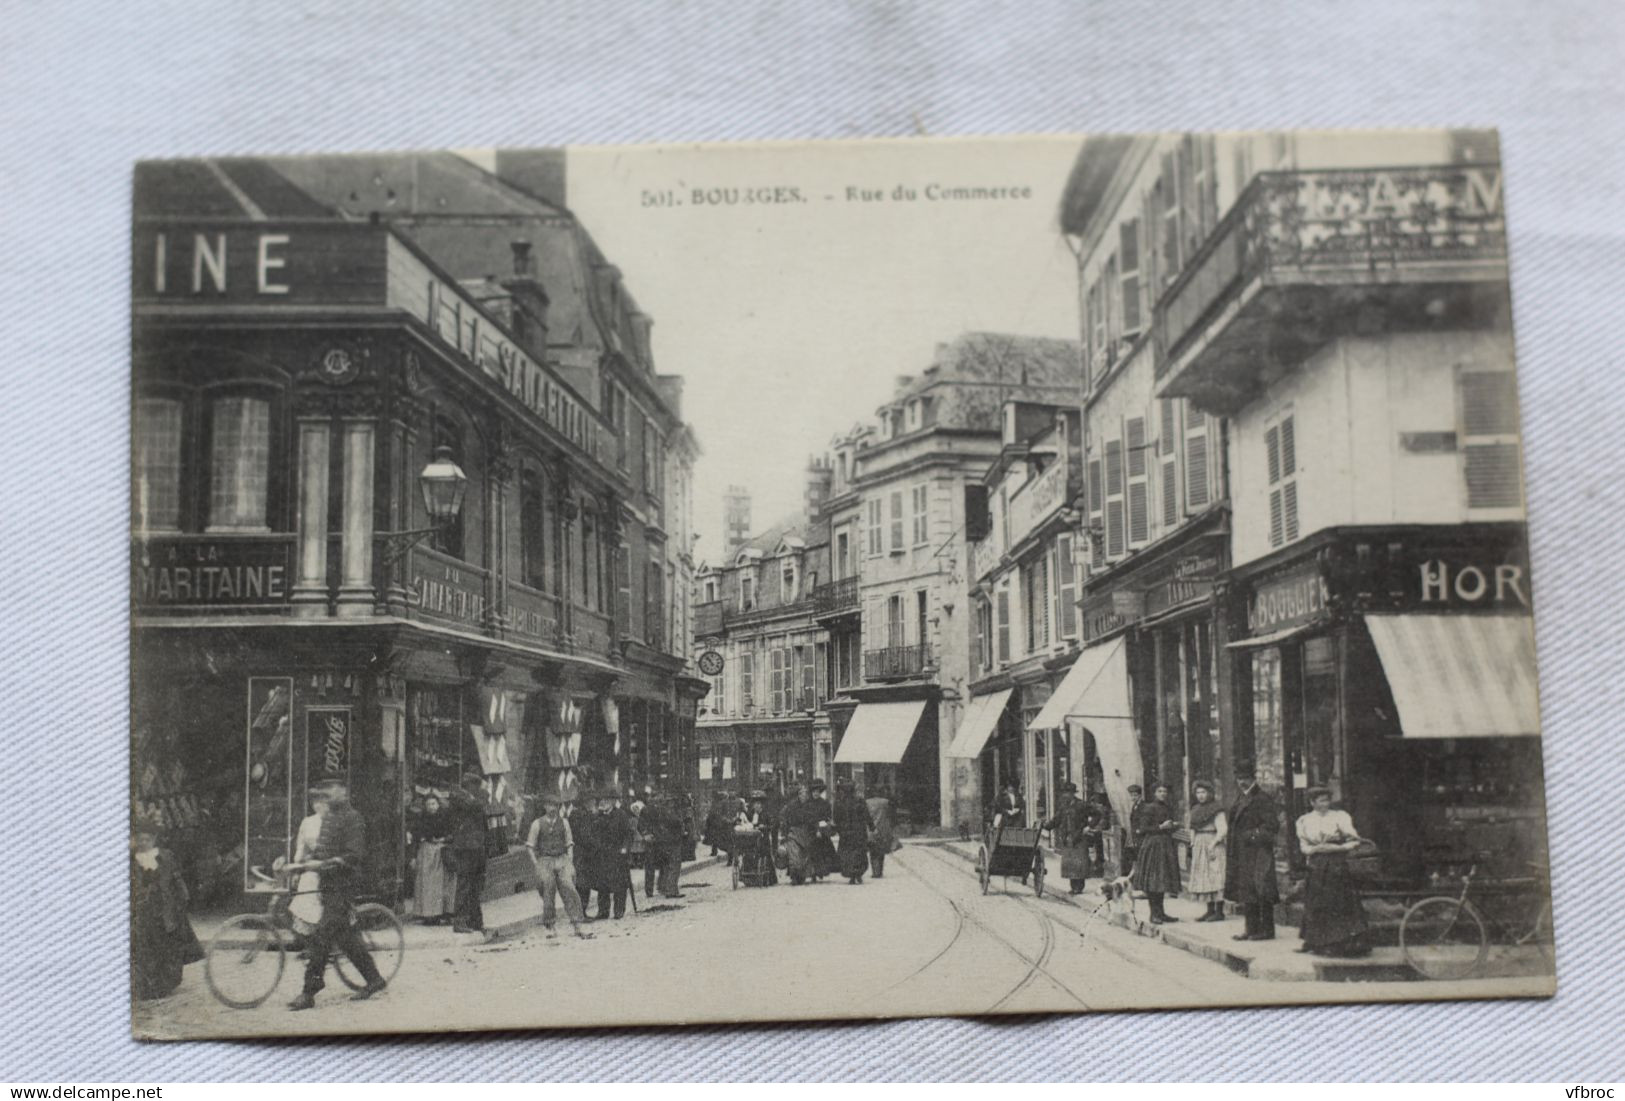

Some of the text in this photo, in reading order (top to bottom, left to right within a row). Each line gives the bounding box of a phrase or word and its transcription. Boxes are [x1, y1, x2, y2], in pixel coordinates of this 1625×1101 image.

[845, 185, 883, 202] Rue
[891, 183, 916, 202] du
[925, 182, 1032, 202] Commerce
[155, 234, 290, 293] INE
[196, 545, 218, 561] LA
